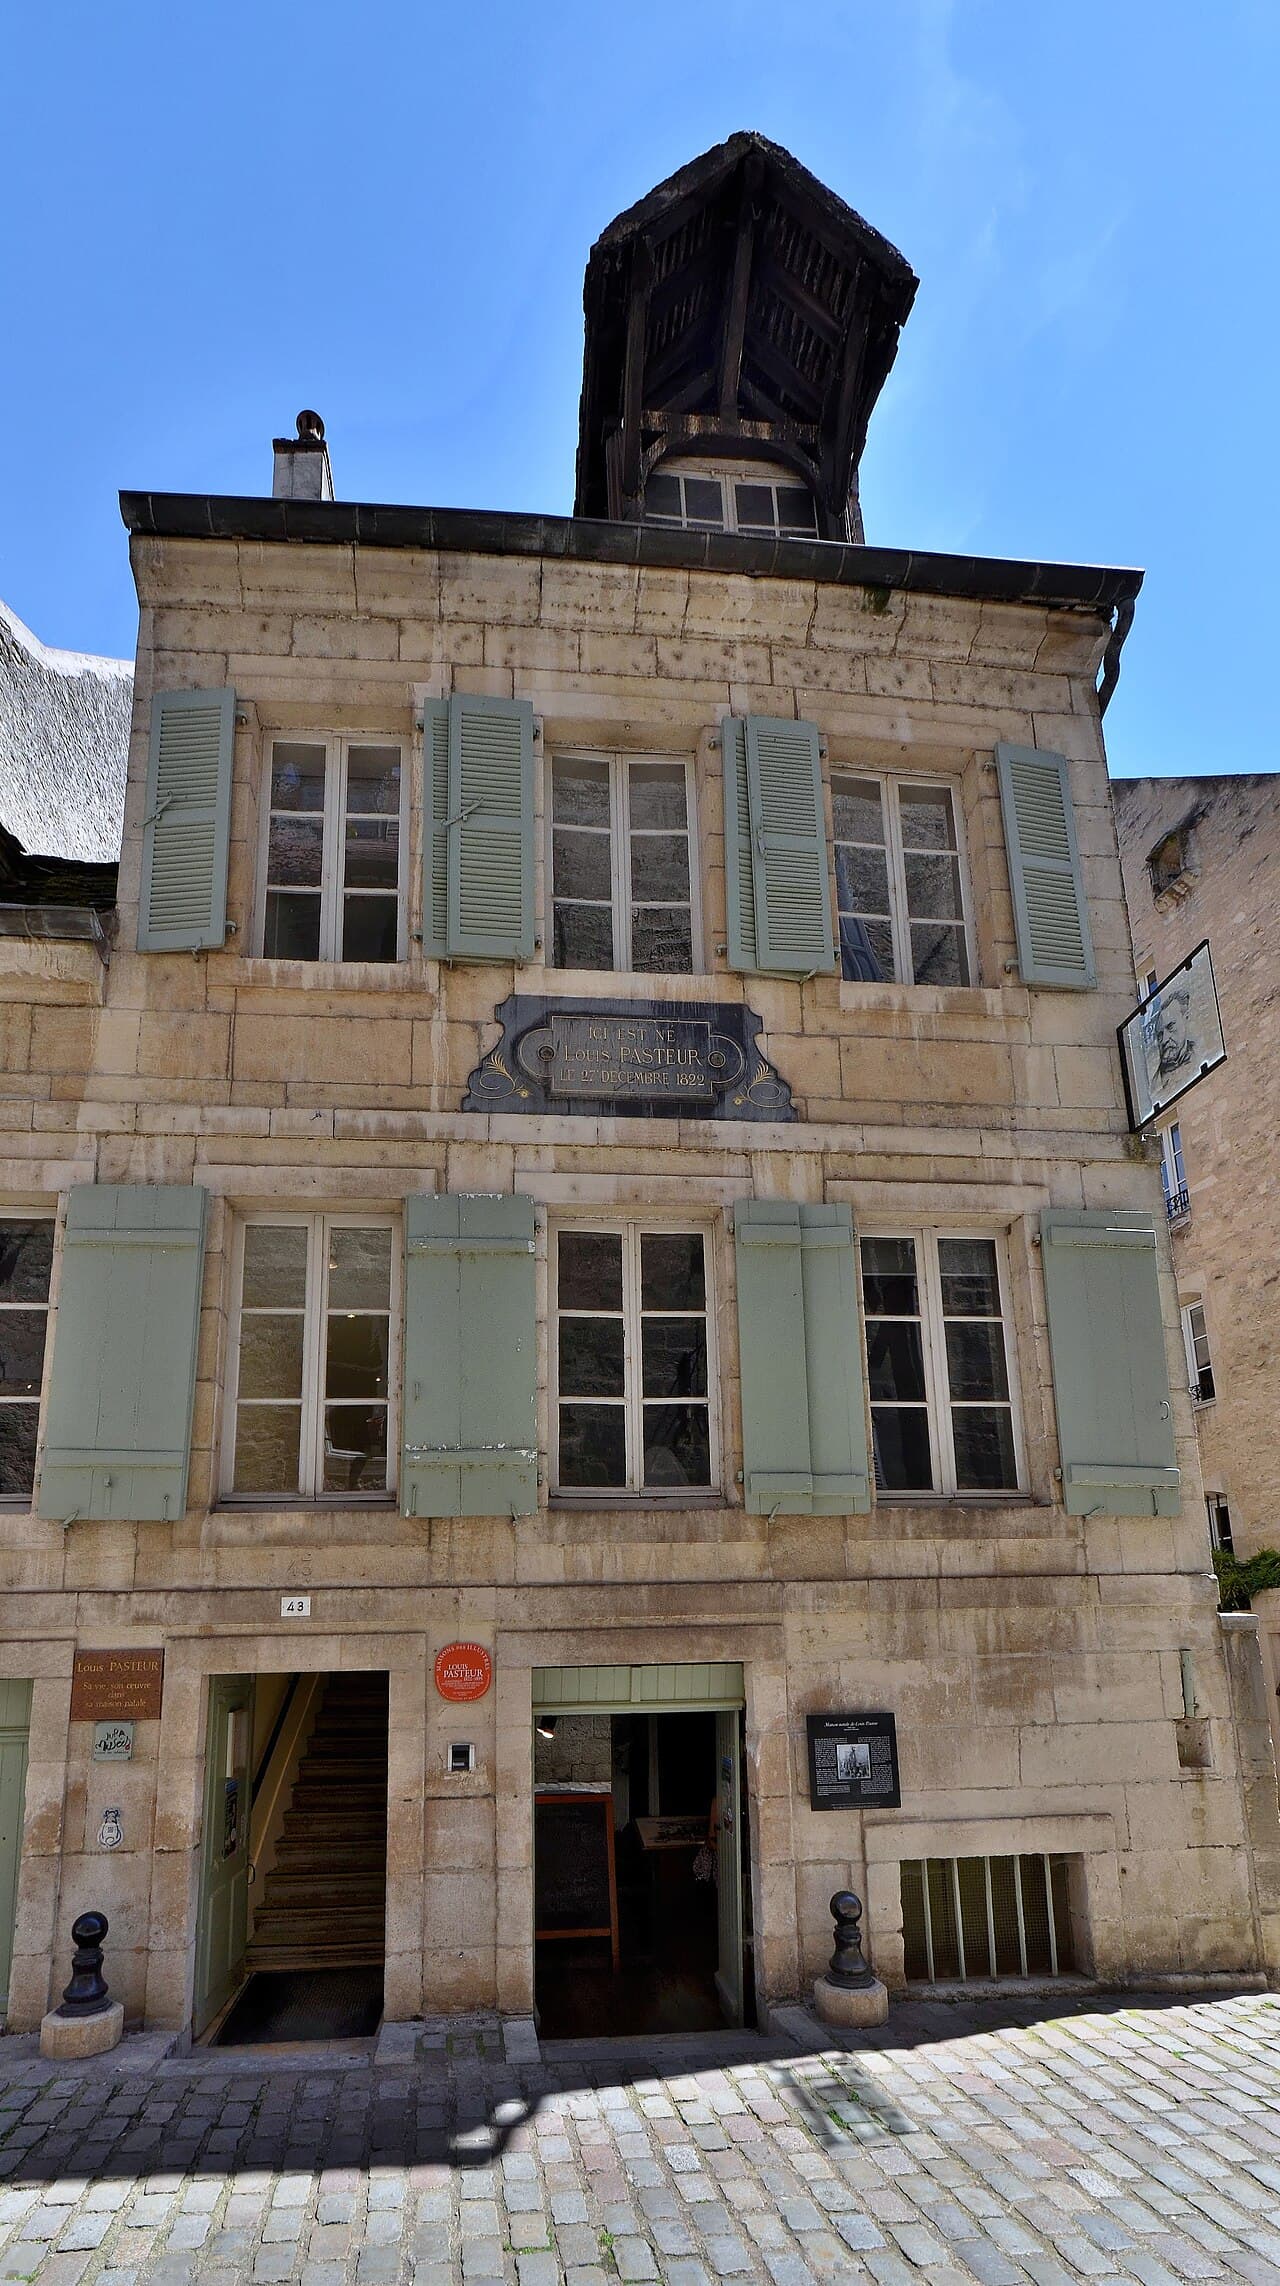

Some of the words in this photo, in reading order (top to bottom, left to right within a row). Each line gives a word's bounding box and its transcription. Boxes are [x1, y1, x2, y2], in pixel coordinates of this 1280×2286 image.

[589, 1026, 608, 1040] ICI
[617, 1028, 647, 1041] EST
[655, 1024, 676, 1042] NÉ
[620, 1046, 703, 1066] PASTEUR
[560, 1069, 575, 1081] LE
[676, 1073, 705, 1086] 1822
[286, 1601, 304, 1612] 43
[109, 1661, 159, 1672] PASTEUR
[443, 1668, 483, 1678] PASTEUR
